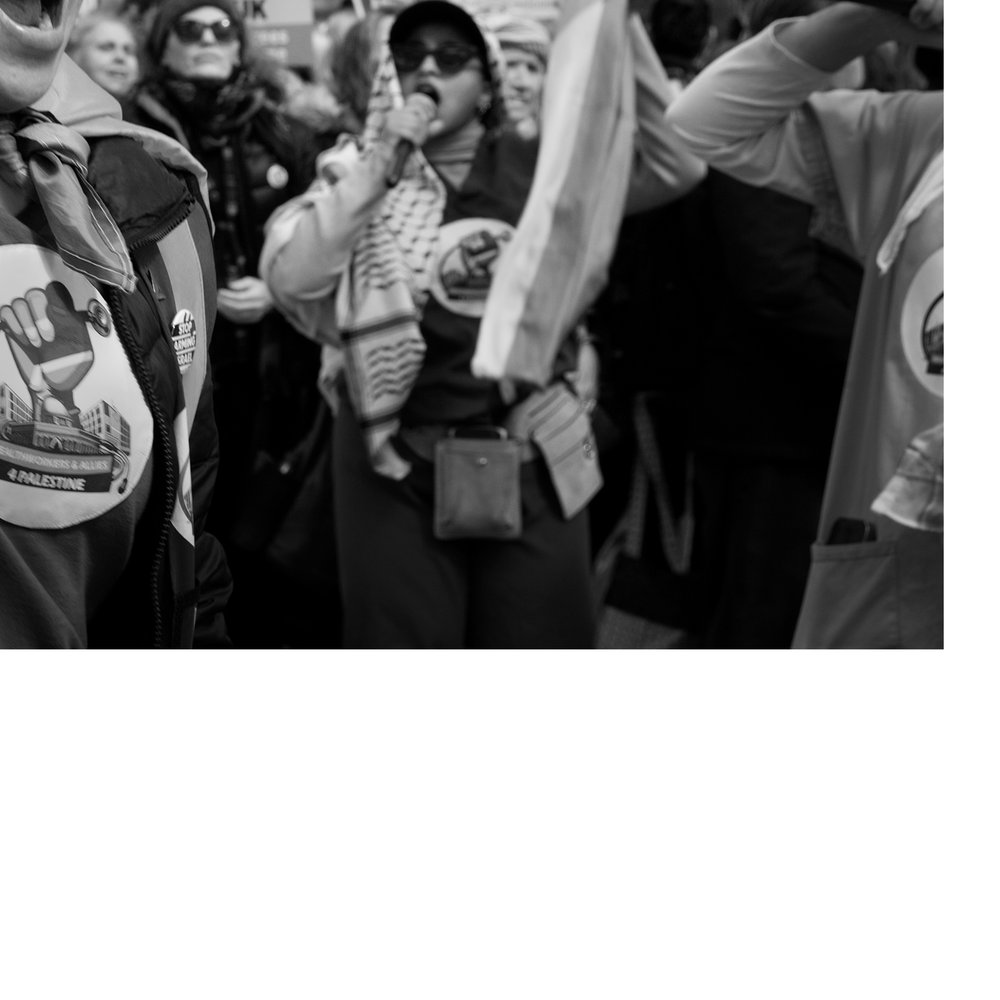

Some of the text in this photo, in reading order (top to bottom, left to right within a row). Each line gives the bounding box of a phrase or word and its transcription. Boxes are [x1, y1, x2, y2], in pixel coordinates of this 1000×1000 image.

[178, 321, 193, 336] STOP
[176, 351, 193, 366] SRAEL
[7, 468, 86, 491] 4 PALESTINE
